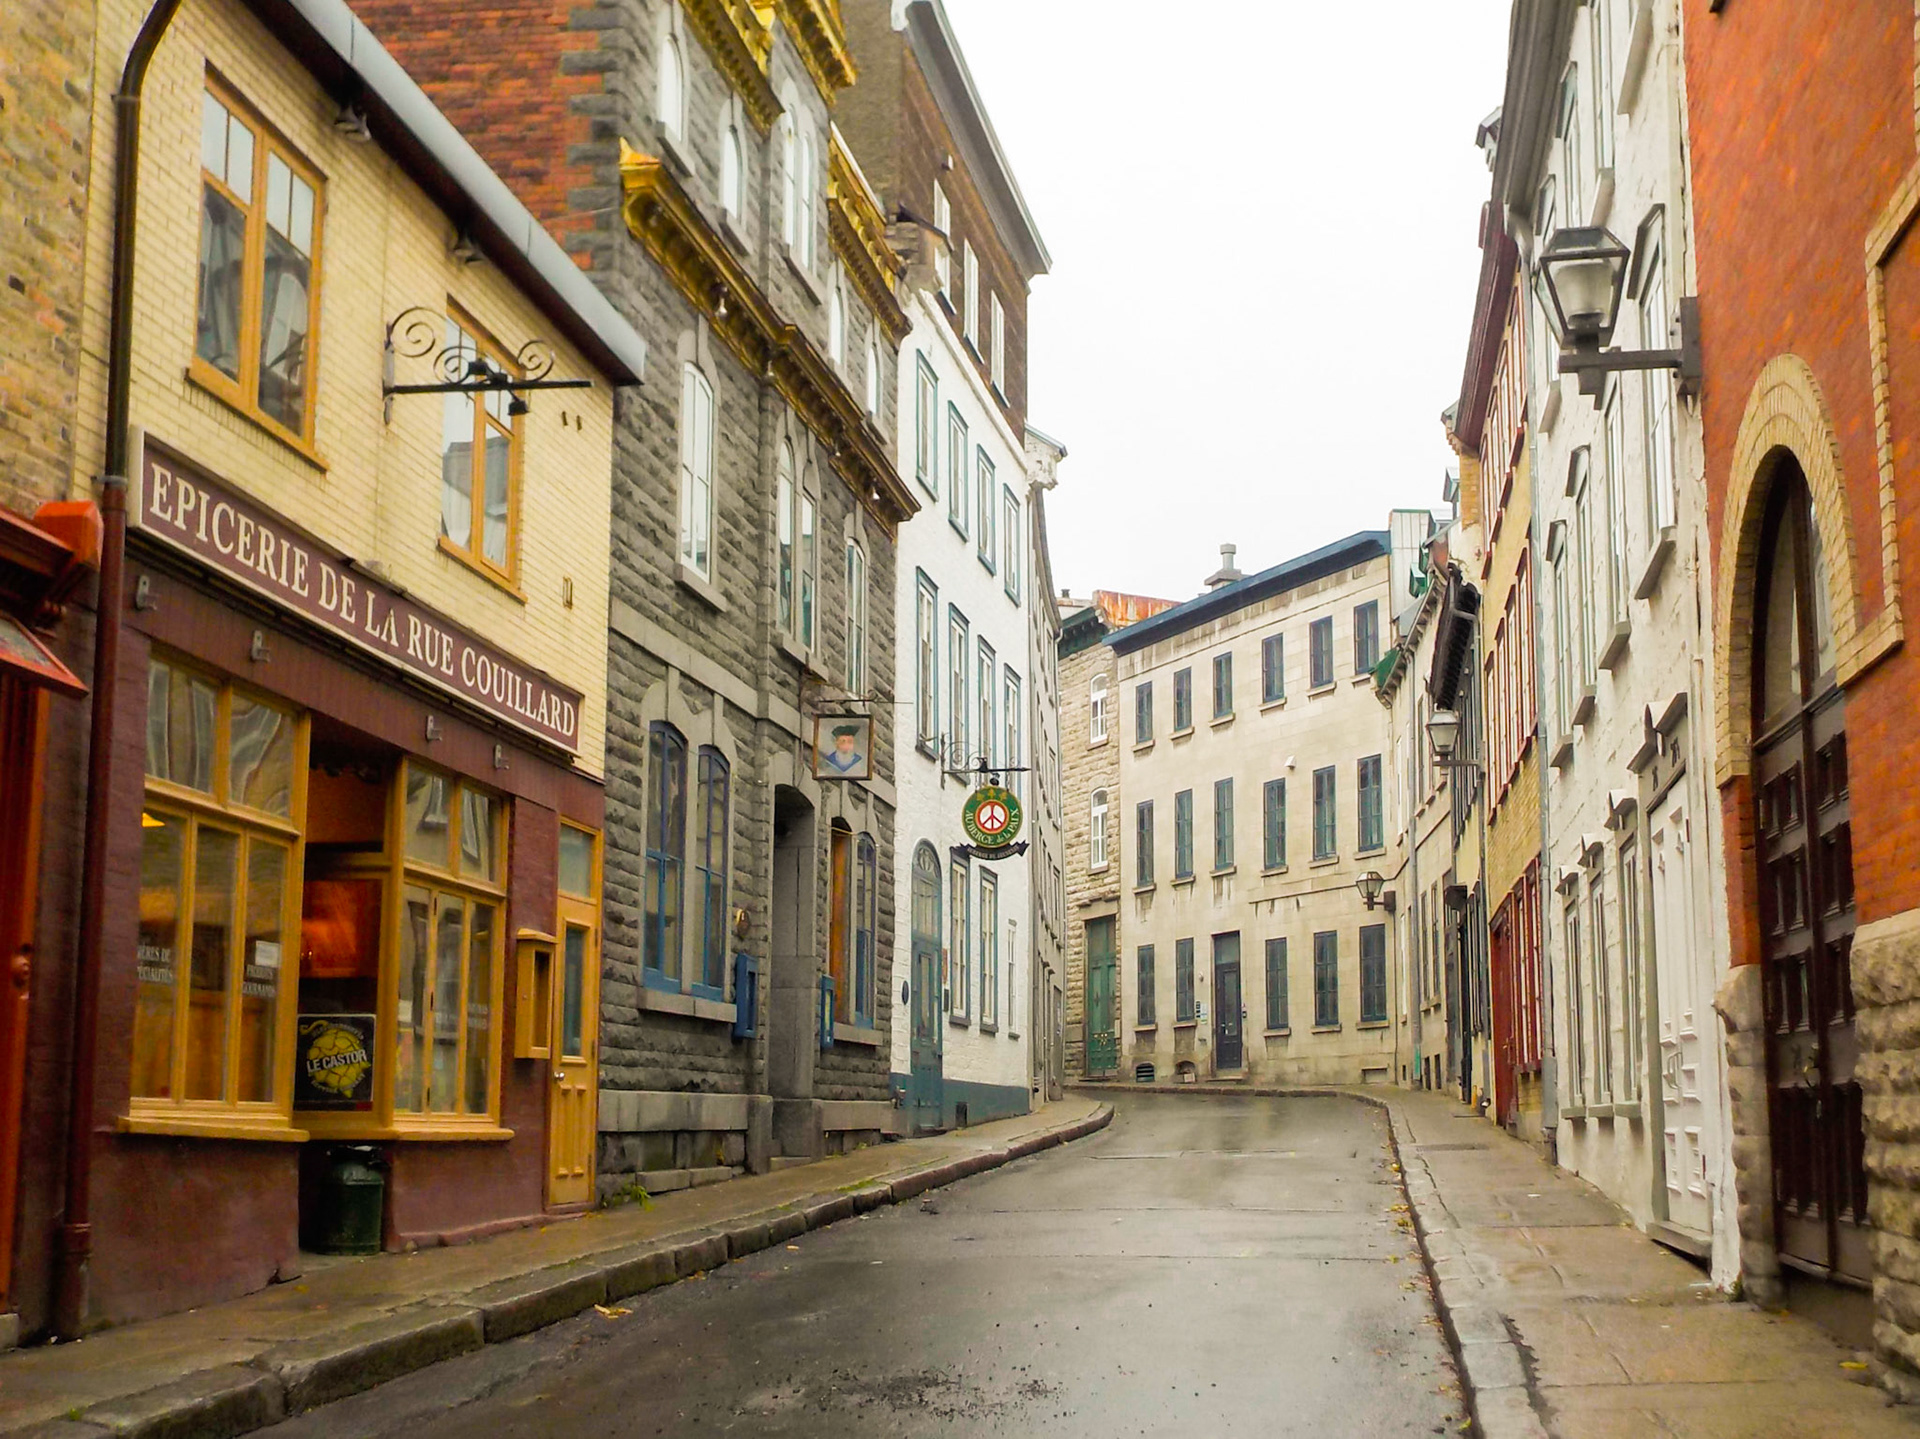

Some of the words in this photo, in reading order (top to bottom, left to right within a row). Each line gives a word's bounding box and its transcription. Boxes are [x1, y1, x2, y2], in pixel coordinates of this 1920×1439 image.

[149, 462, 309, 598] EPICERIE
[317, 561, 356, 624] DE
[364, 589, 399, 648] LA
[407, 613, 454, 677] RUE
[461, 646, 576, 738] COUILLARD
[965, 809, 995, 845] AUBERGE
[1008, 807, 1020, 833] PAIX
[306, 1059, 322, 1073] LE
[322, 1049, 368, 1069] CASTOR
